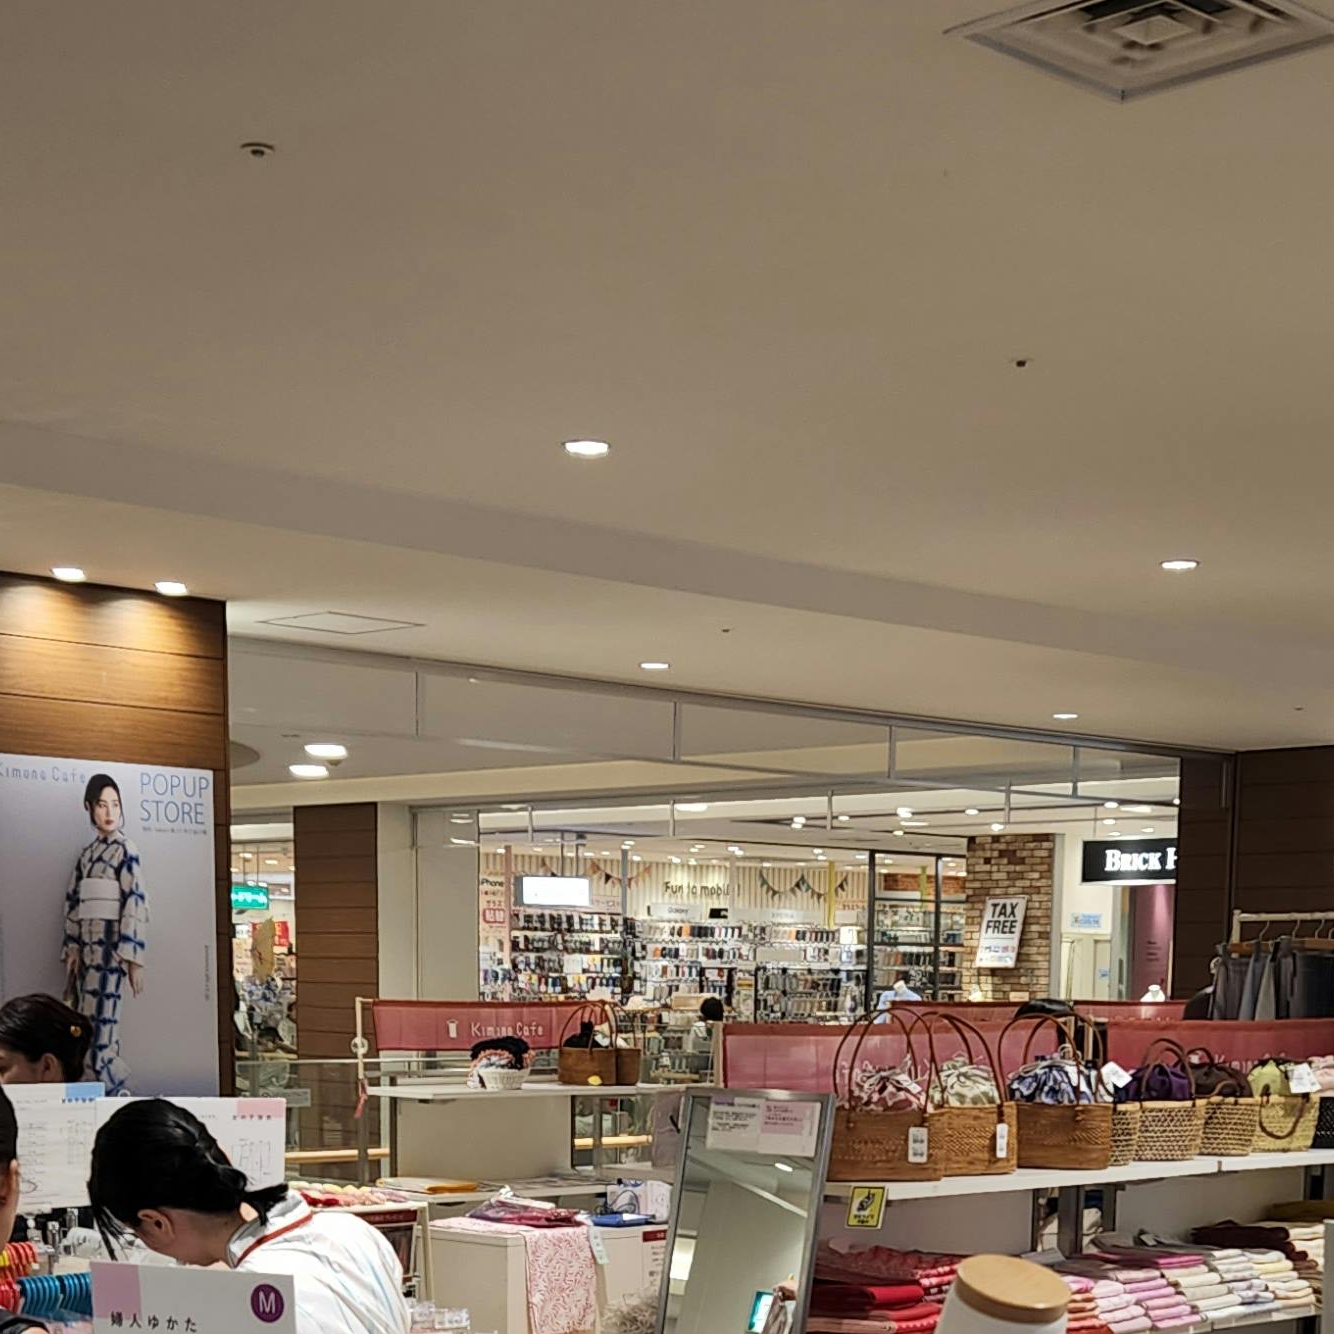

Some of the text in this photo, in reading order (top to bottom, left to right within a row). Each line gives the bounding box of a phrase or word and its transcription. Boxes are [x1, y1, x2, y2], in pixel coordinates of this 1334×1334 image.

[139, 771, 210, 799] POPUP
[139, 799, 205, 825] STORE
[1104, 848, 1162, 872] BRICK
[480, 878, 505, 888] iPhone
[665, 880, 683, 895] Fun
[990, 901, 1019, 919] TAX
[985, 919, 1018, 935] FREE
[516, 1021, 544, 1037] Cafe
[258, 1290, 277, 1315] M
[110, 1310, 198, 1334] 婦人ゆかた
